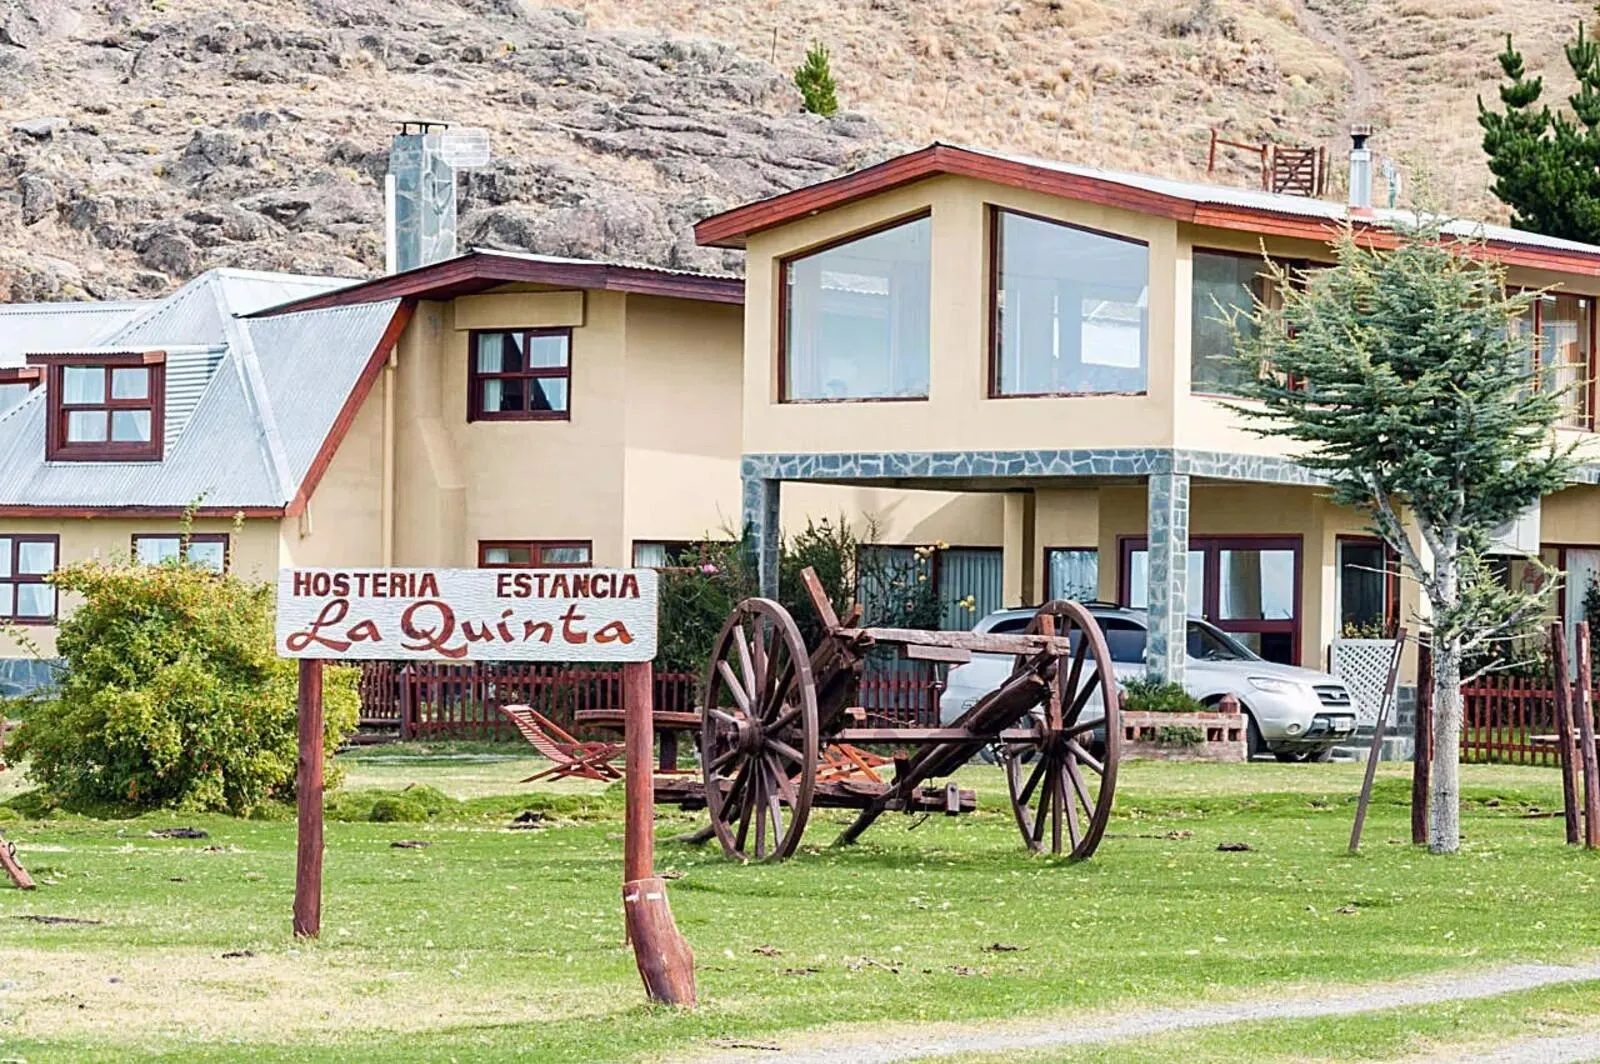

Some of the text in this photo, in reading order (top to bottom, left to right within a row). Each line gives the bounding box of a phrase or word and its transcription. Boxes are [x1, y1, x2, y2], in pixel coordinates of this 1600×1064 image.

[293, 571, 641, 599] HOSTERIA ESTANCIA
[286, 599, 635, 658] La Quinta
